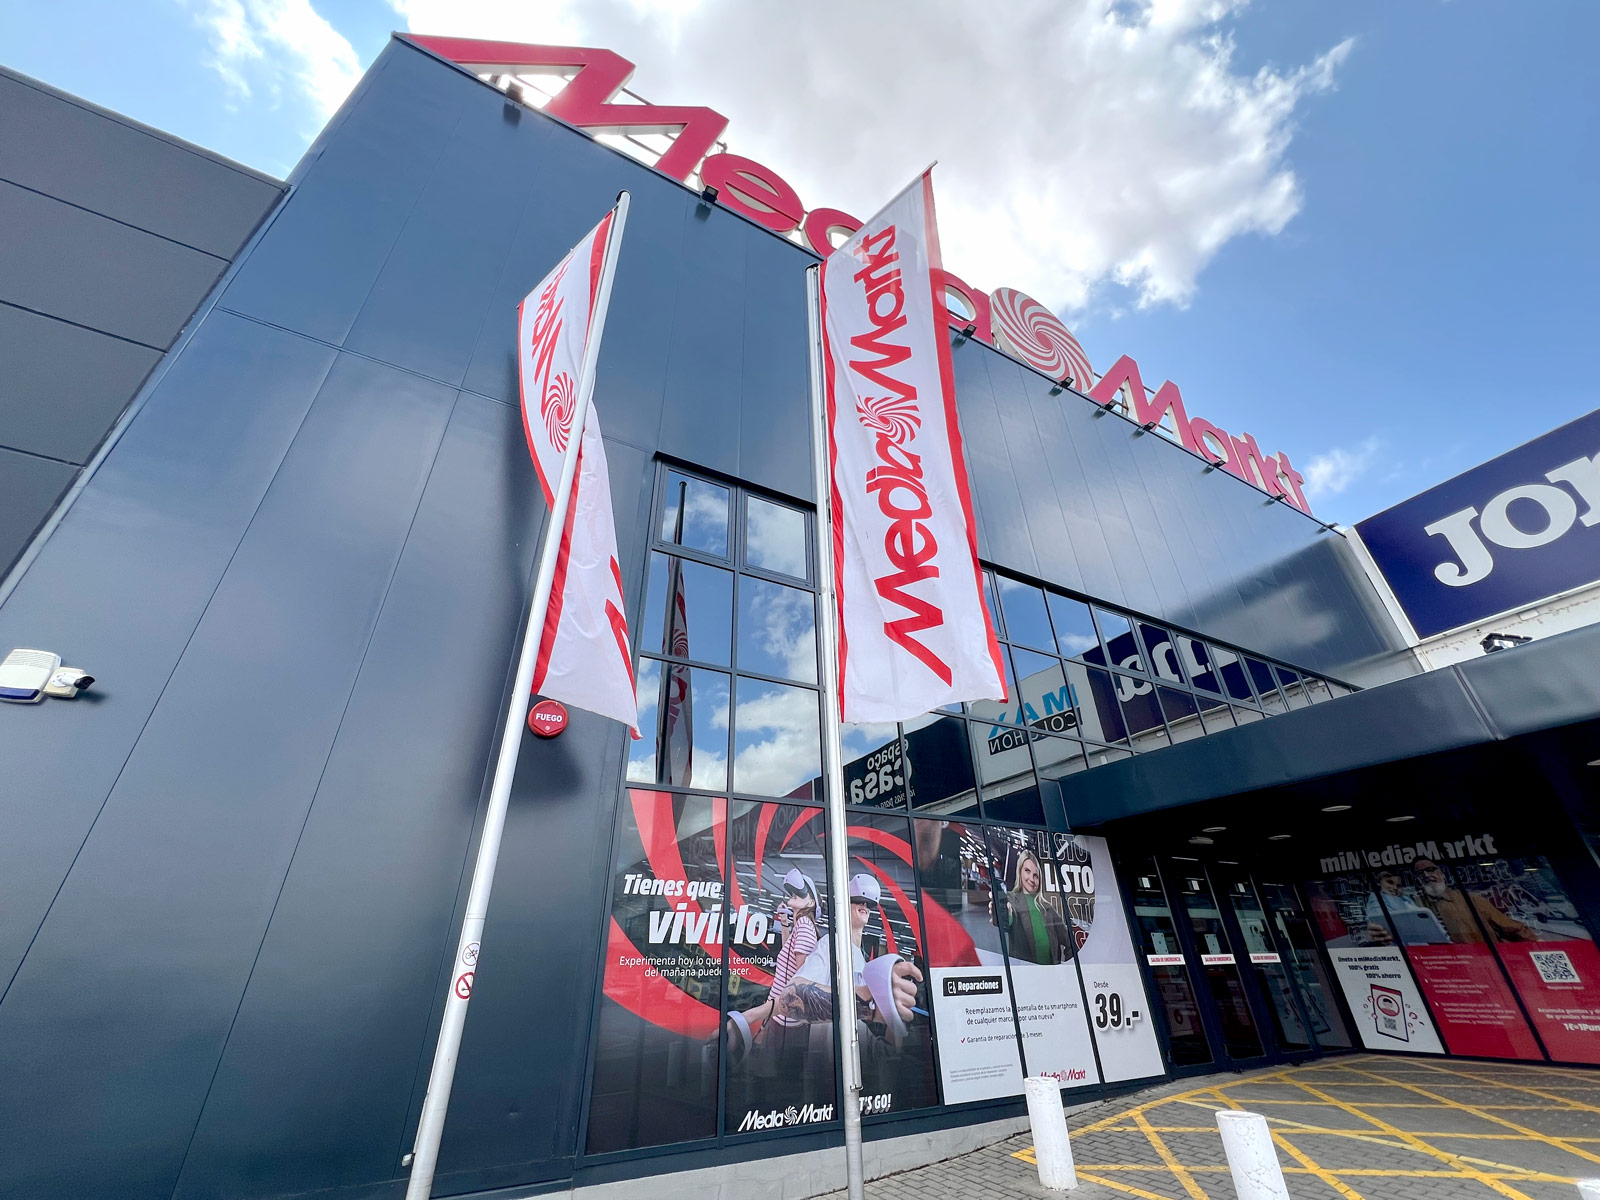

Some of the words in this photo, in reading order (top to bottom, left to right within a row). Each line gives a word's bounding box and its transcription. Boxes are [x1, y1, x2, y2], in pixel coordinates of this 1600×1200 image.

[387, 33, 993, 344] Mea
[1086, 354, 1313, 516] Markt
[849, 224, 918, 401] Markt
[866, 432, 952, 687] Media
[535, 712, 563, 723] FUEGO
[623, 873, 685, 897] Tienes
[686, 880, 721, 901] que
[1044, 862, 1096, 894] LISTO
[619, 956, 677, 968] Experimenta
[678, 955, 693, 967] hoy
[695, 955, 703, 966] lo
[706, 957, 722, 968] que
[732, 955, 774, 967] tecnología
[644, 967, 658, 977] del
[660, 968, 696, 977] mañana
[957, 980, 999, 992] Reparaciones
[965, 1006, 1006, 1016] Reemplazamos
[1050, 1003, 1078, 1012] smartphone
[1095, 992, 1139, 1029] 39.-
[966, 1017, 974, 1026] de
[974, 1016, 998, 1026] cualquier
[873, 1093, 892, 1110] GO!
[738, 1109, 784, 1132] Media
[795, 1103, 834, 1125] Markt
